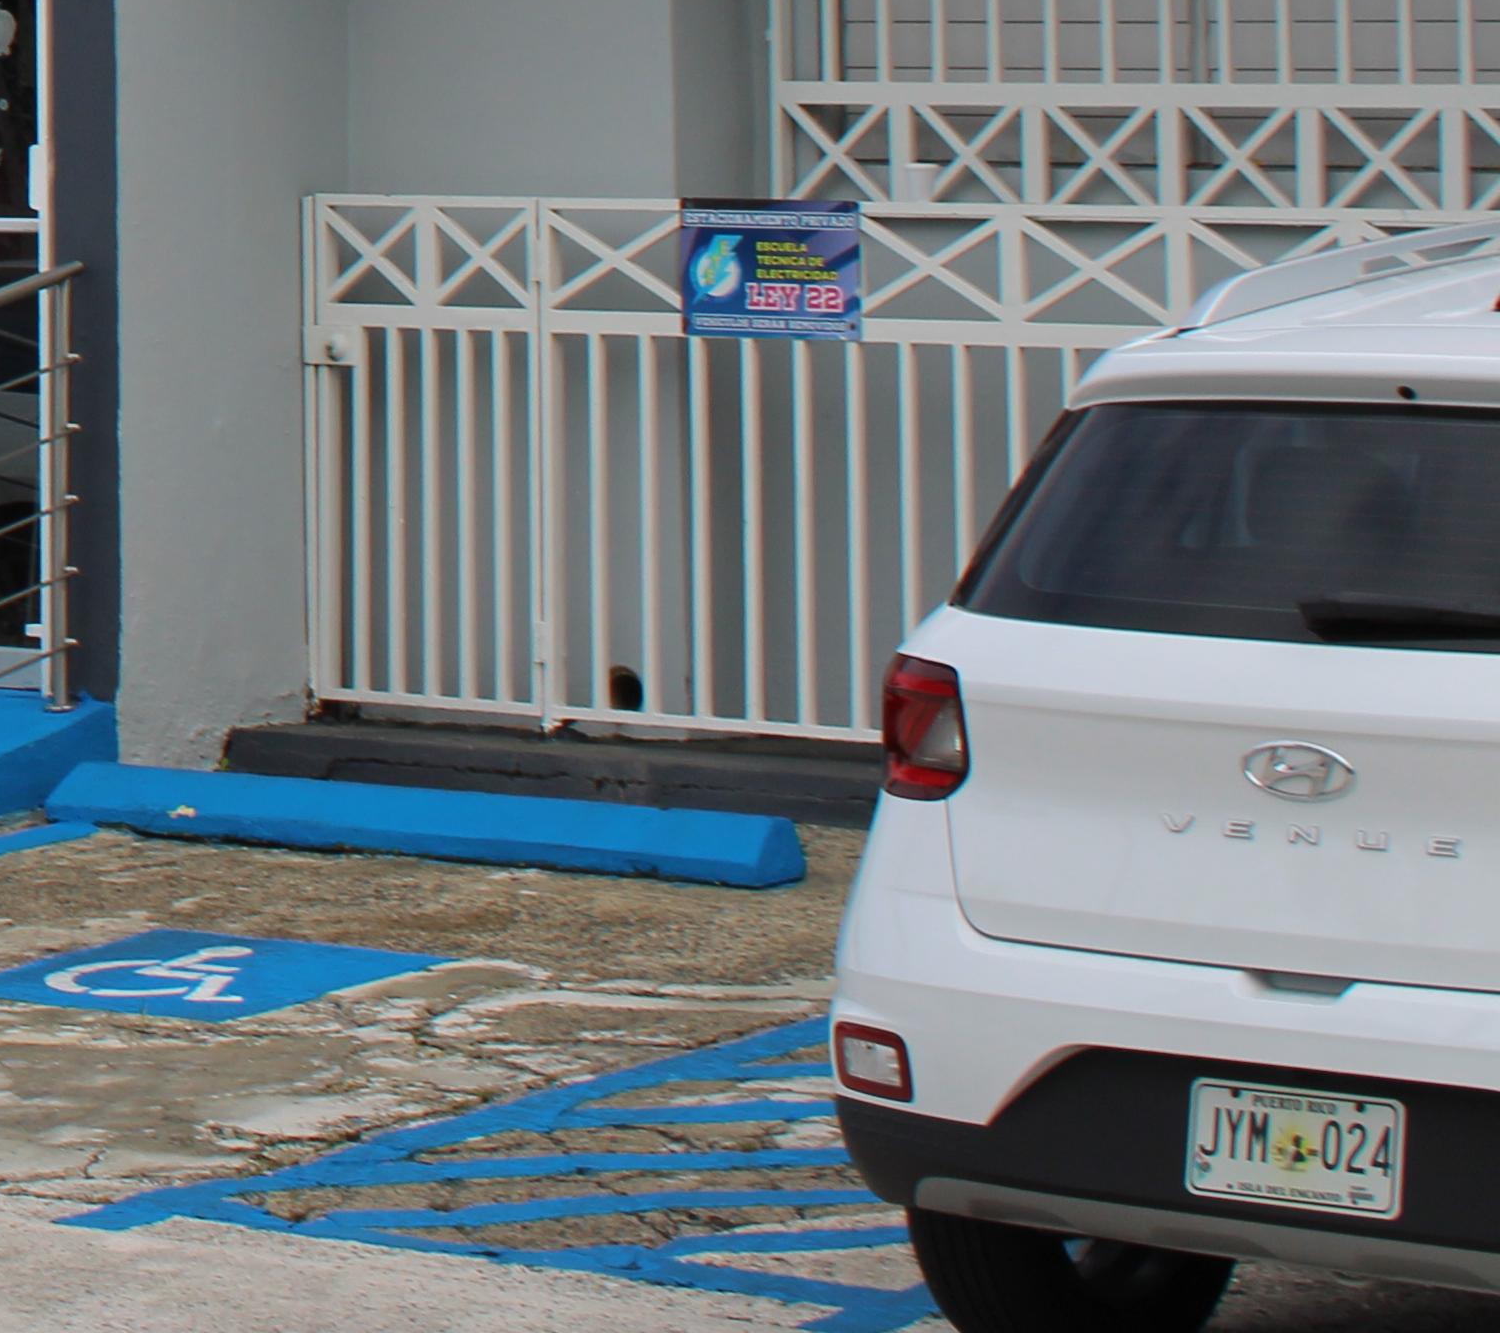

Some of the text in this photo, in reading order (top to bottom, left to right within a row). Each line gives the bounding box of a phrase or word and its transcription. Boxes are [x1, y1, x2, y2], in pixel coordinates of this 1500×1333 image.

[755, 241, 809, 253] ESCUELA
[807, 256, 826, 267] DE
[755, 269, 839, 281] ELECTRICIDAD
[745, 282, 845, 313] LEY 22
[1161, 812, 1462, 858] VENUE
[1252, 1094, 1337, 1115] PUERTO RICO
[1198, 1106, 1394, 1178] JYM 024
[1236, 1181, 1264, 1194] ISLA
[1289, 1188, 1343, 1203] ENCANTO
